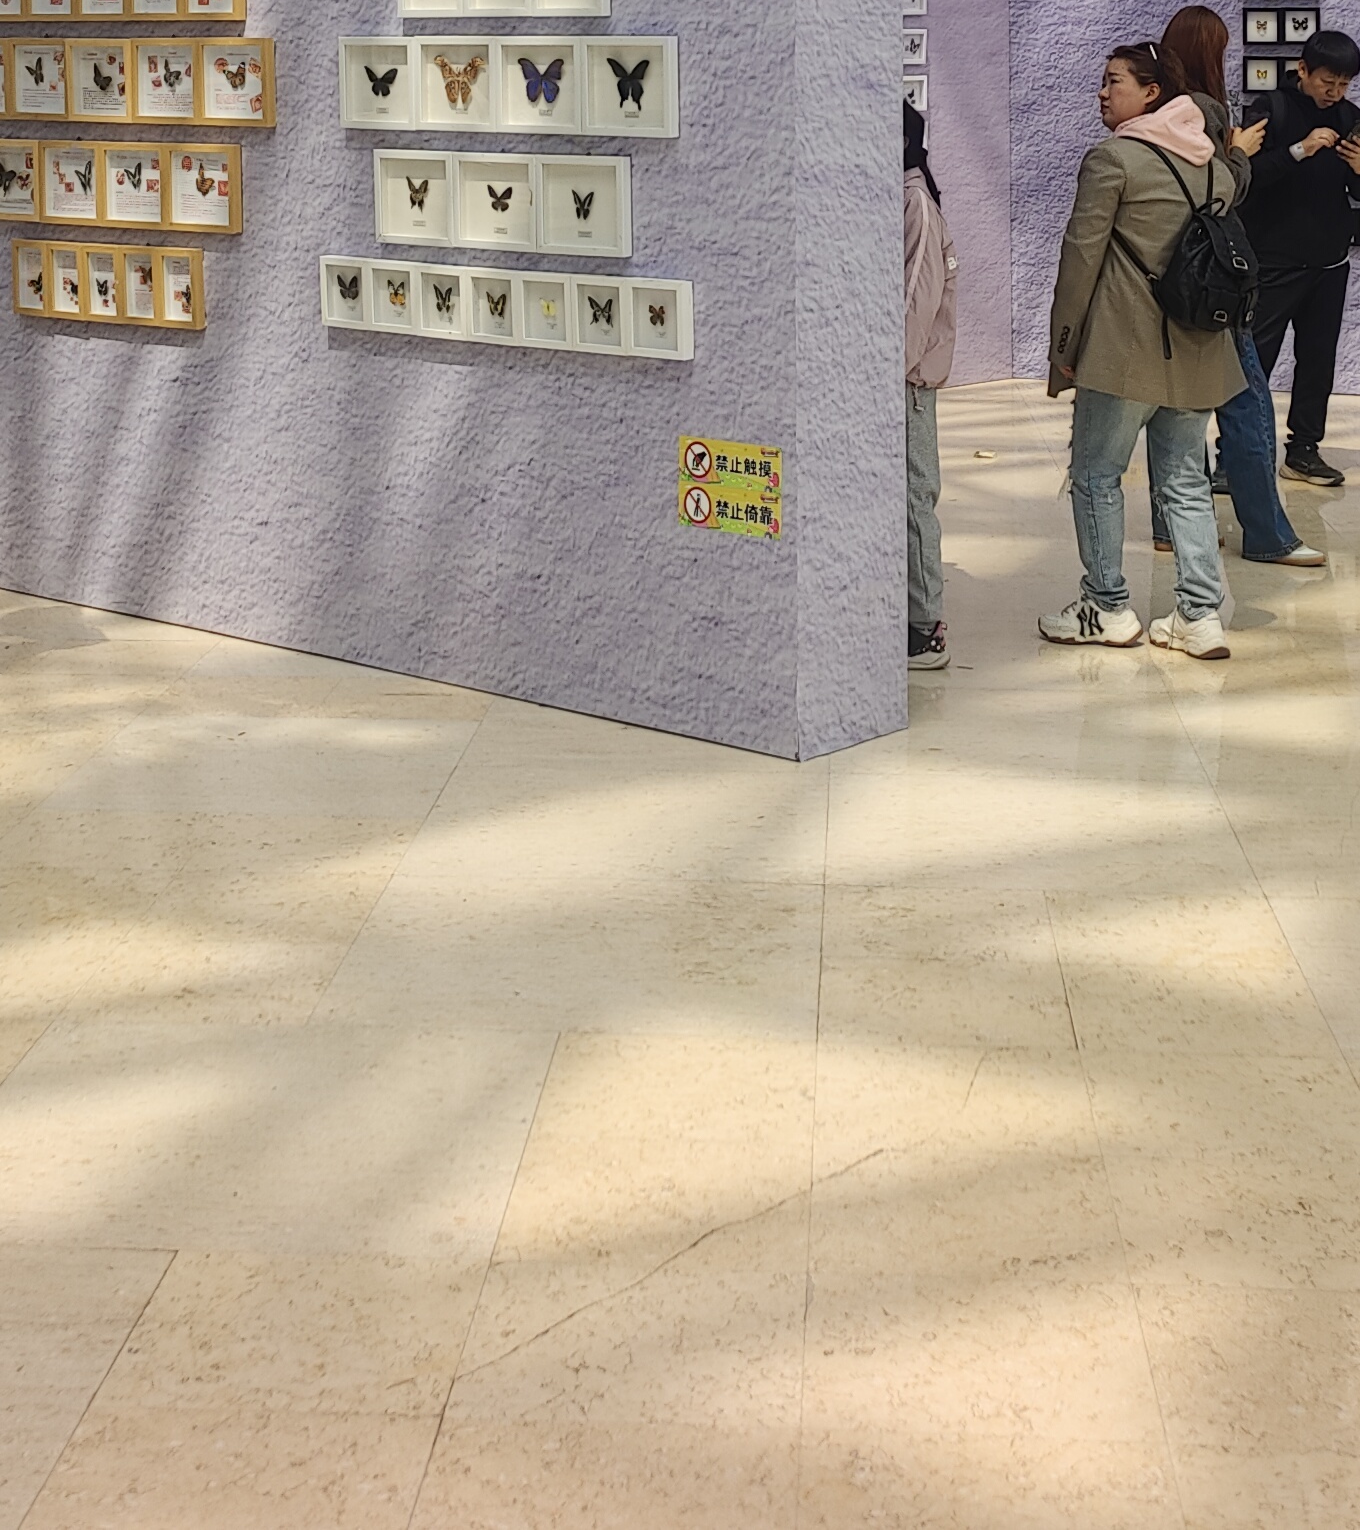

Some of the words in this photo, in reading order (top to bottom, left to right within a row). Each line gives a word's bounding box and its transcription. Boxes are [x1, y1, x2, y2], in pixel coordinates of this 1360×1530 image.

[715, 454, 772, 478] 禁止触摸
[715, 499, 774, 526] 禁止倚靠
